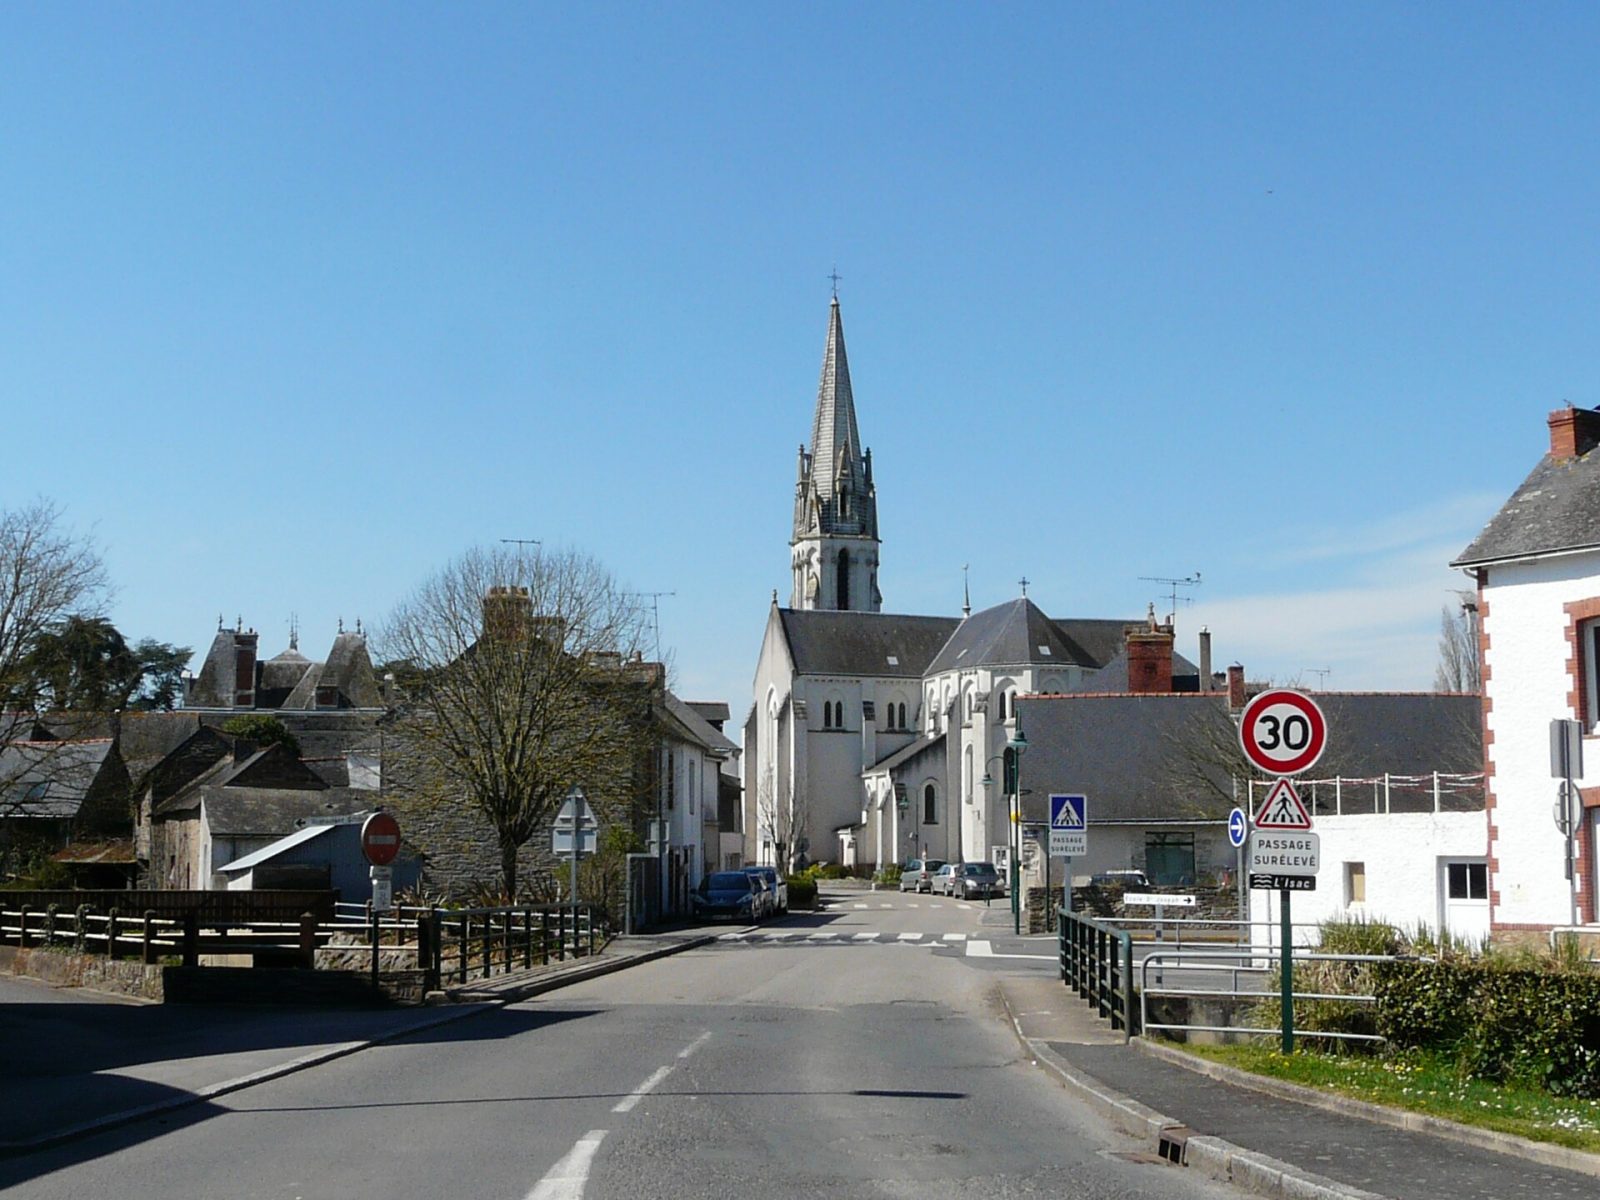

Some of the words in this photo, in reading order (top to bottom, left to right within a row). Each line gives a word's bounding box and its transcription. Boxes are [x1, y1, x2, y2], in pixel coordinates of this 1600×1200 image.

[1258, 715, 1309, 751] 30
[1258, 839, 1312, 851] PASSAGE
[1254, 853, 1316, 867] SURÉLEVÉ
[1274, 876, 1311, 889] L'Isac
